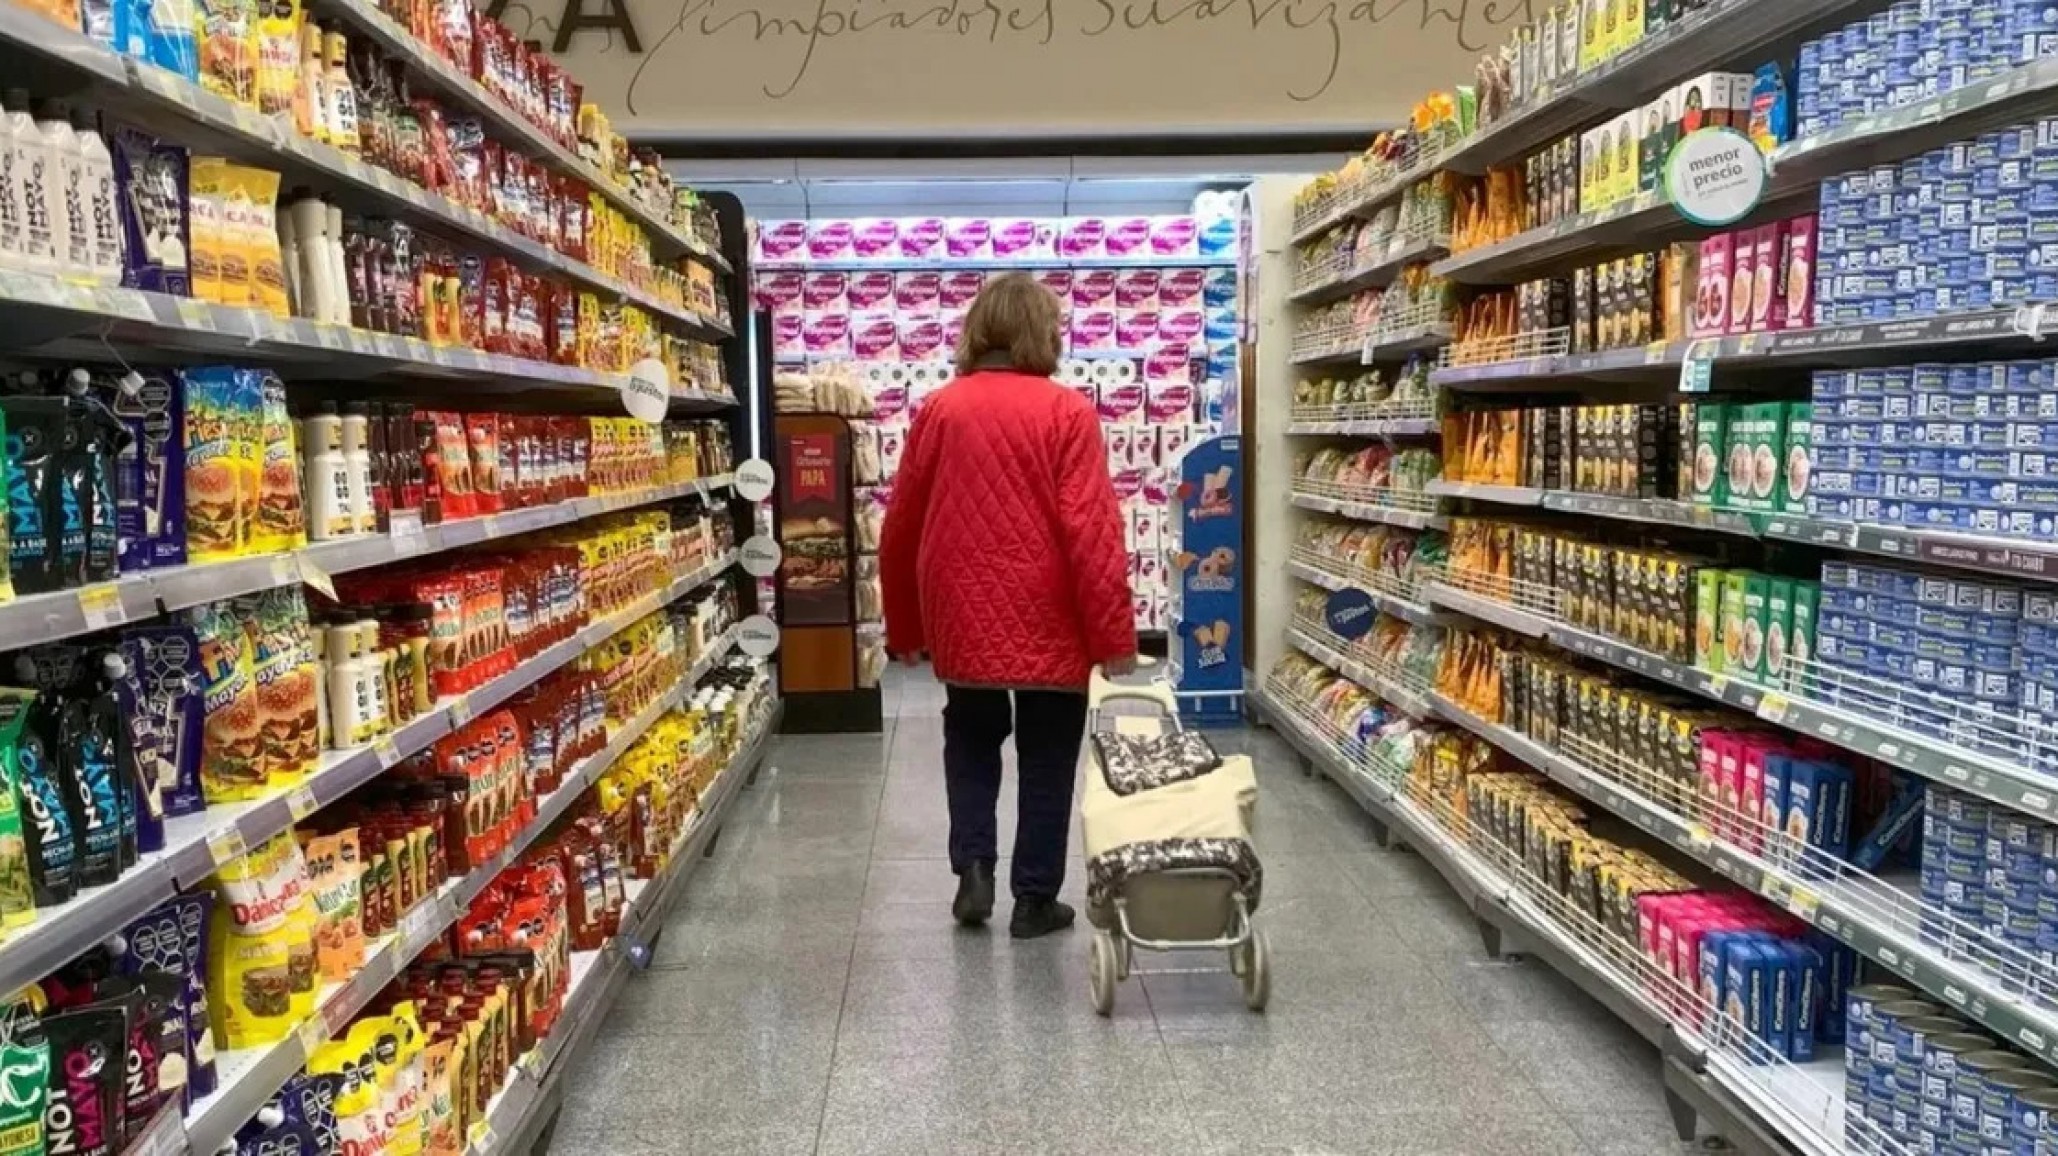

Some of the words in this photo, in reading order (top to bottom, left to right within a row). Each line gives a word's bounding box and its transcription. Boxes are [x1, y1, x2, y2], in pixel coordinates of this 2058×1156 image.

[1688, 147, 1741, 172] menor
[1692, 163, 1744, 190] precio
[23, 178, 38, 227] NOT
[32, 159, 49, 229] MAYO
[64, 187, 78, 233] NOT
[91, 193, 106, 240] NOT
[99, 176, 114, 240] MAYO
[6, 432, 44, 535] MAYO
[20, 774, 60, 845] NOT
[74, 763, 103, 831] NOT
[45, 1086, 77, 1155] NOT
[64, 1050, 105, 1150] MAYO
